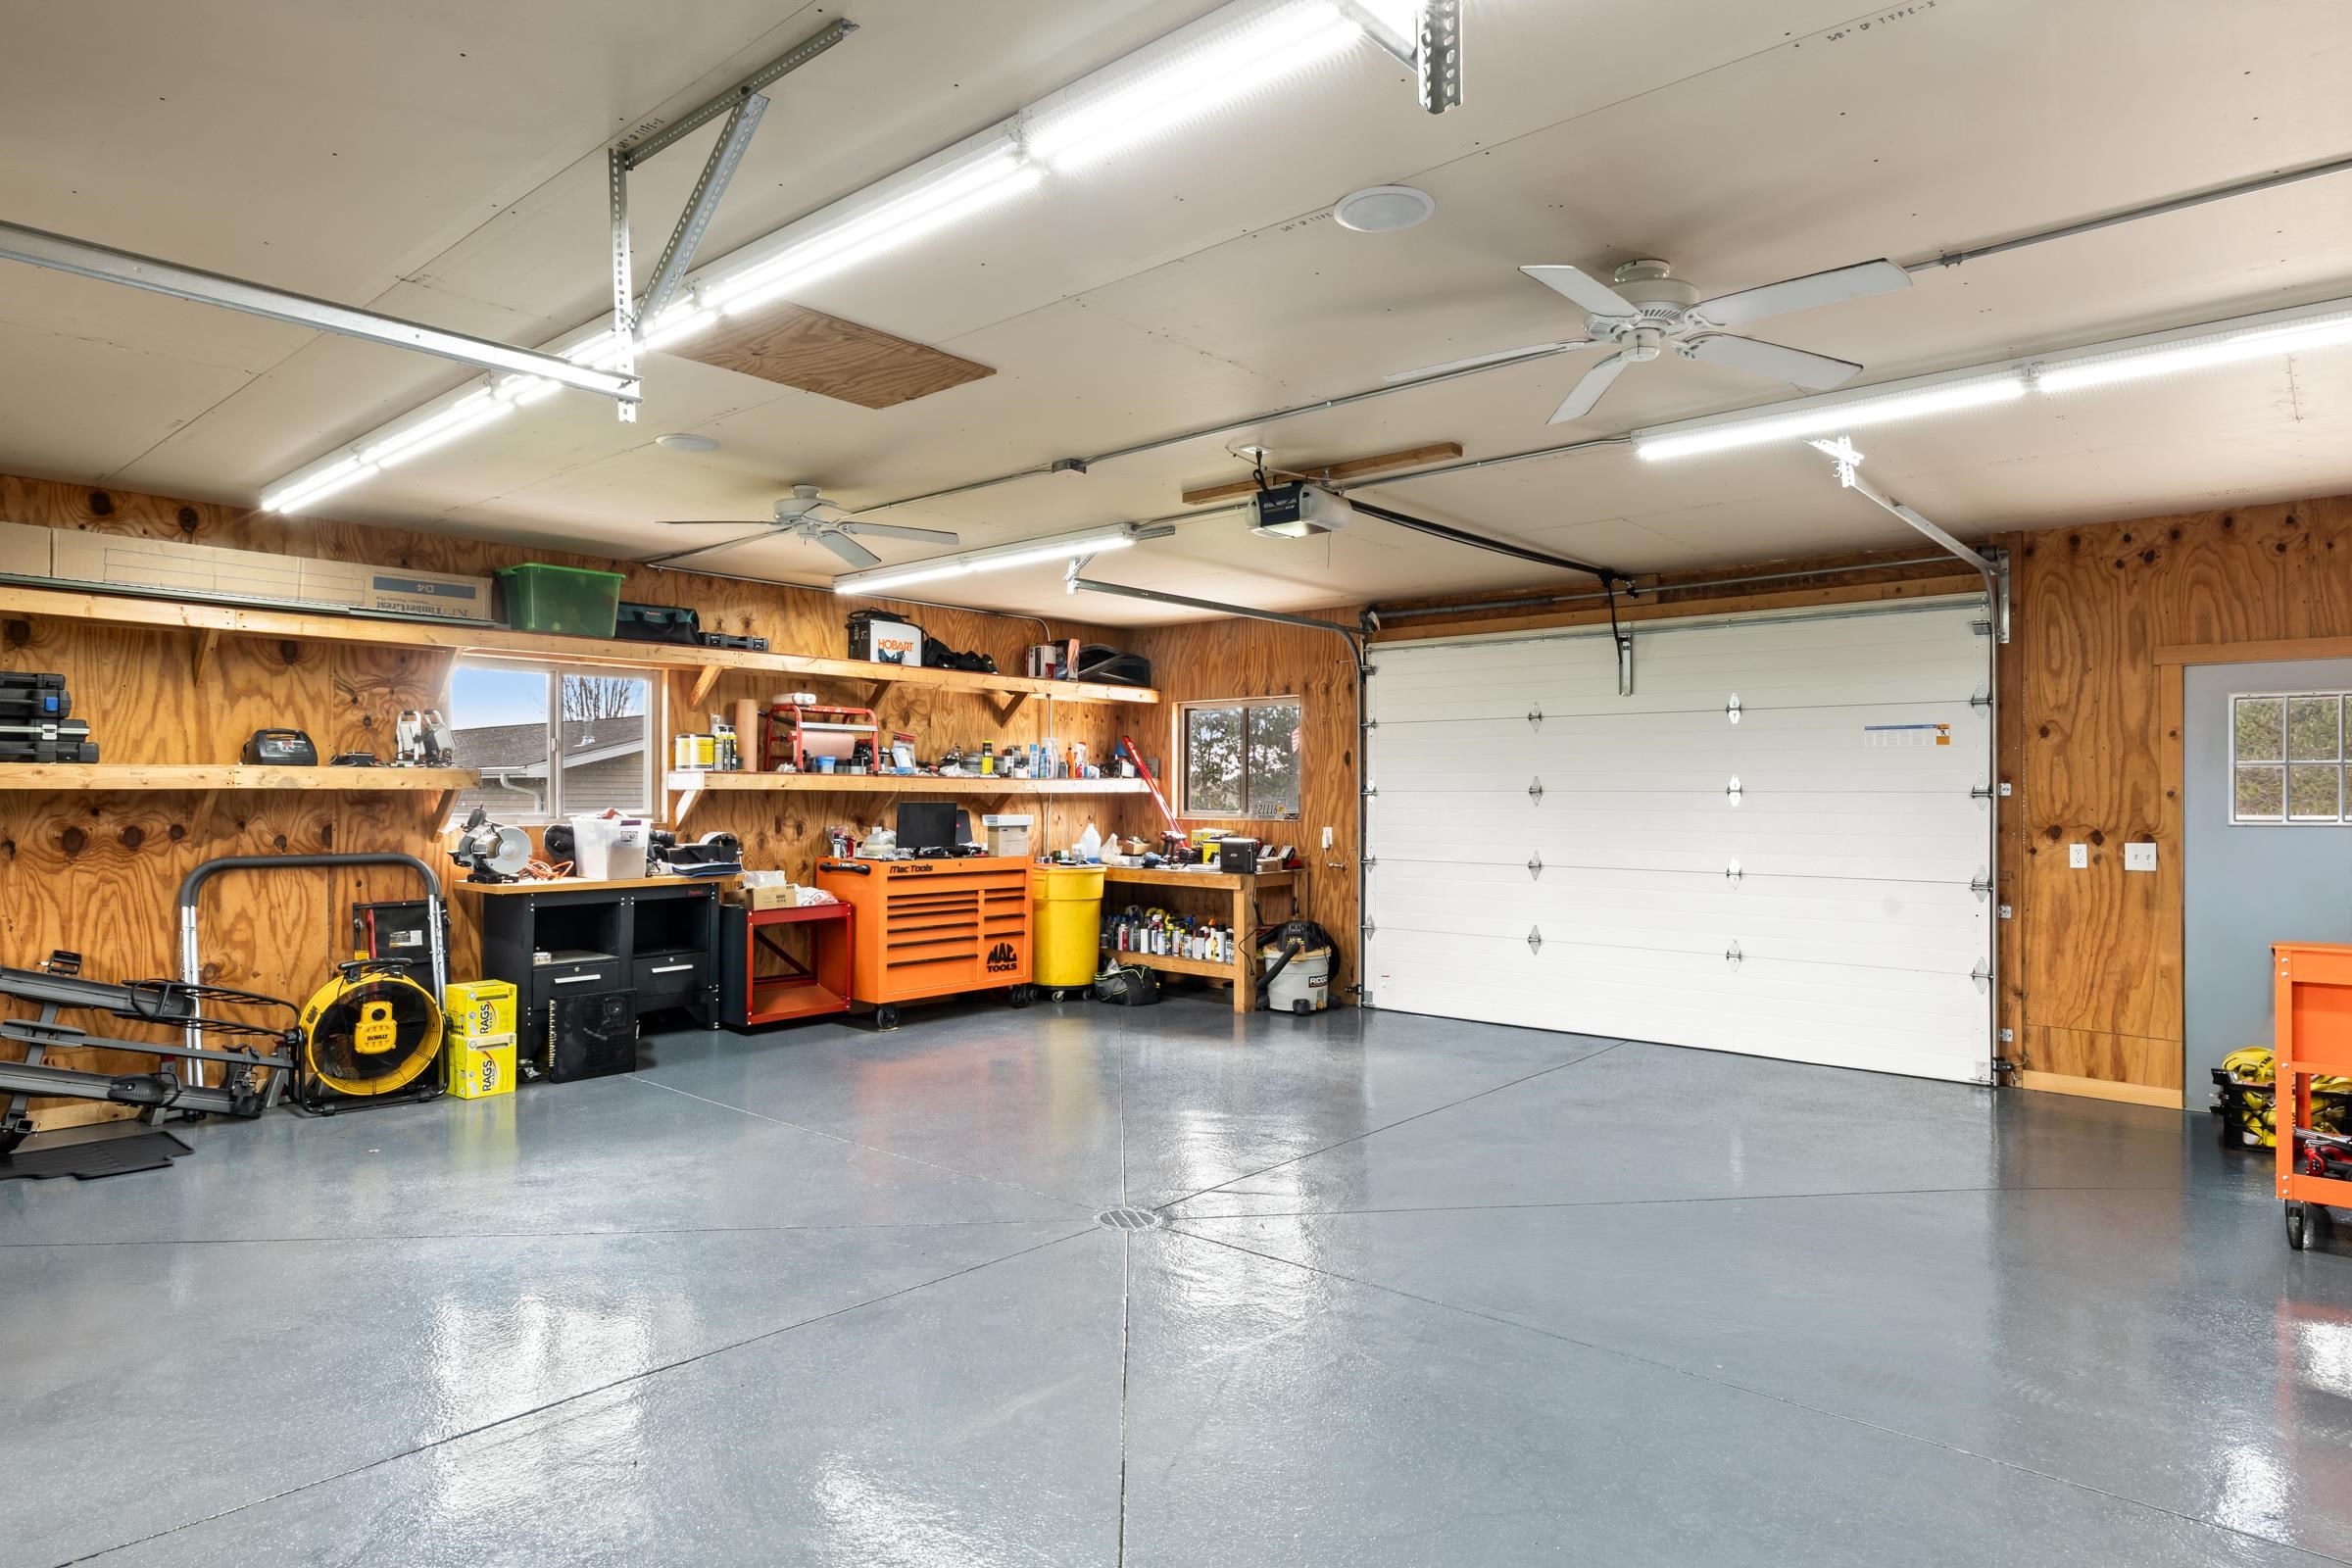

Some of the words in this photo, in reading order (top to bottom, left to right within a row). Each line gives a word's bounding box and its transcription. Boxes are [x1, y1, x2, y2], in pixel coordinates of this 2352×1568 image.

[1878, 0, 1936, 24] TYPE-X
[416, 583, 434, 593] D4
[877, 638, 913, 652] HOBART
[910, 863, 933, 872] Tools
[987, 942, 1017, 964] MAC
[987, 962, 1017, 972] TOOLS
[479, 1004, 490, 1034] RAGS
[482, 1059, 492, 1092] RAGS
